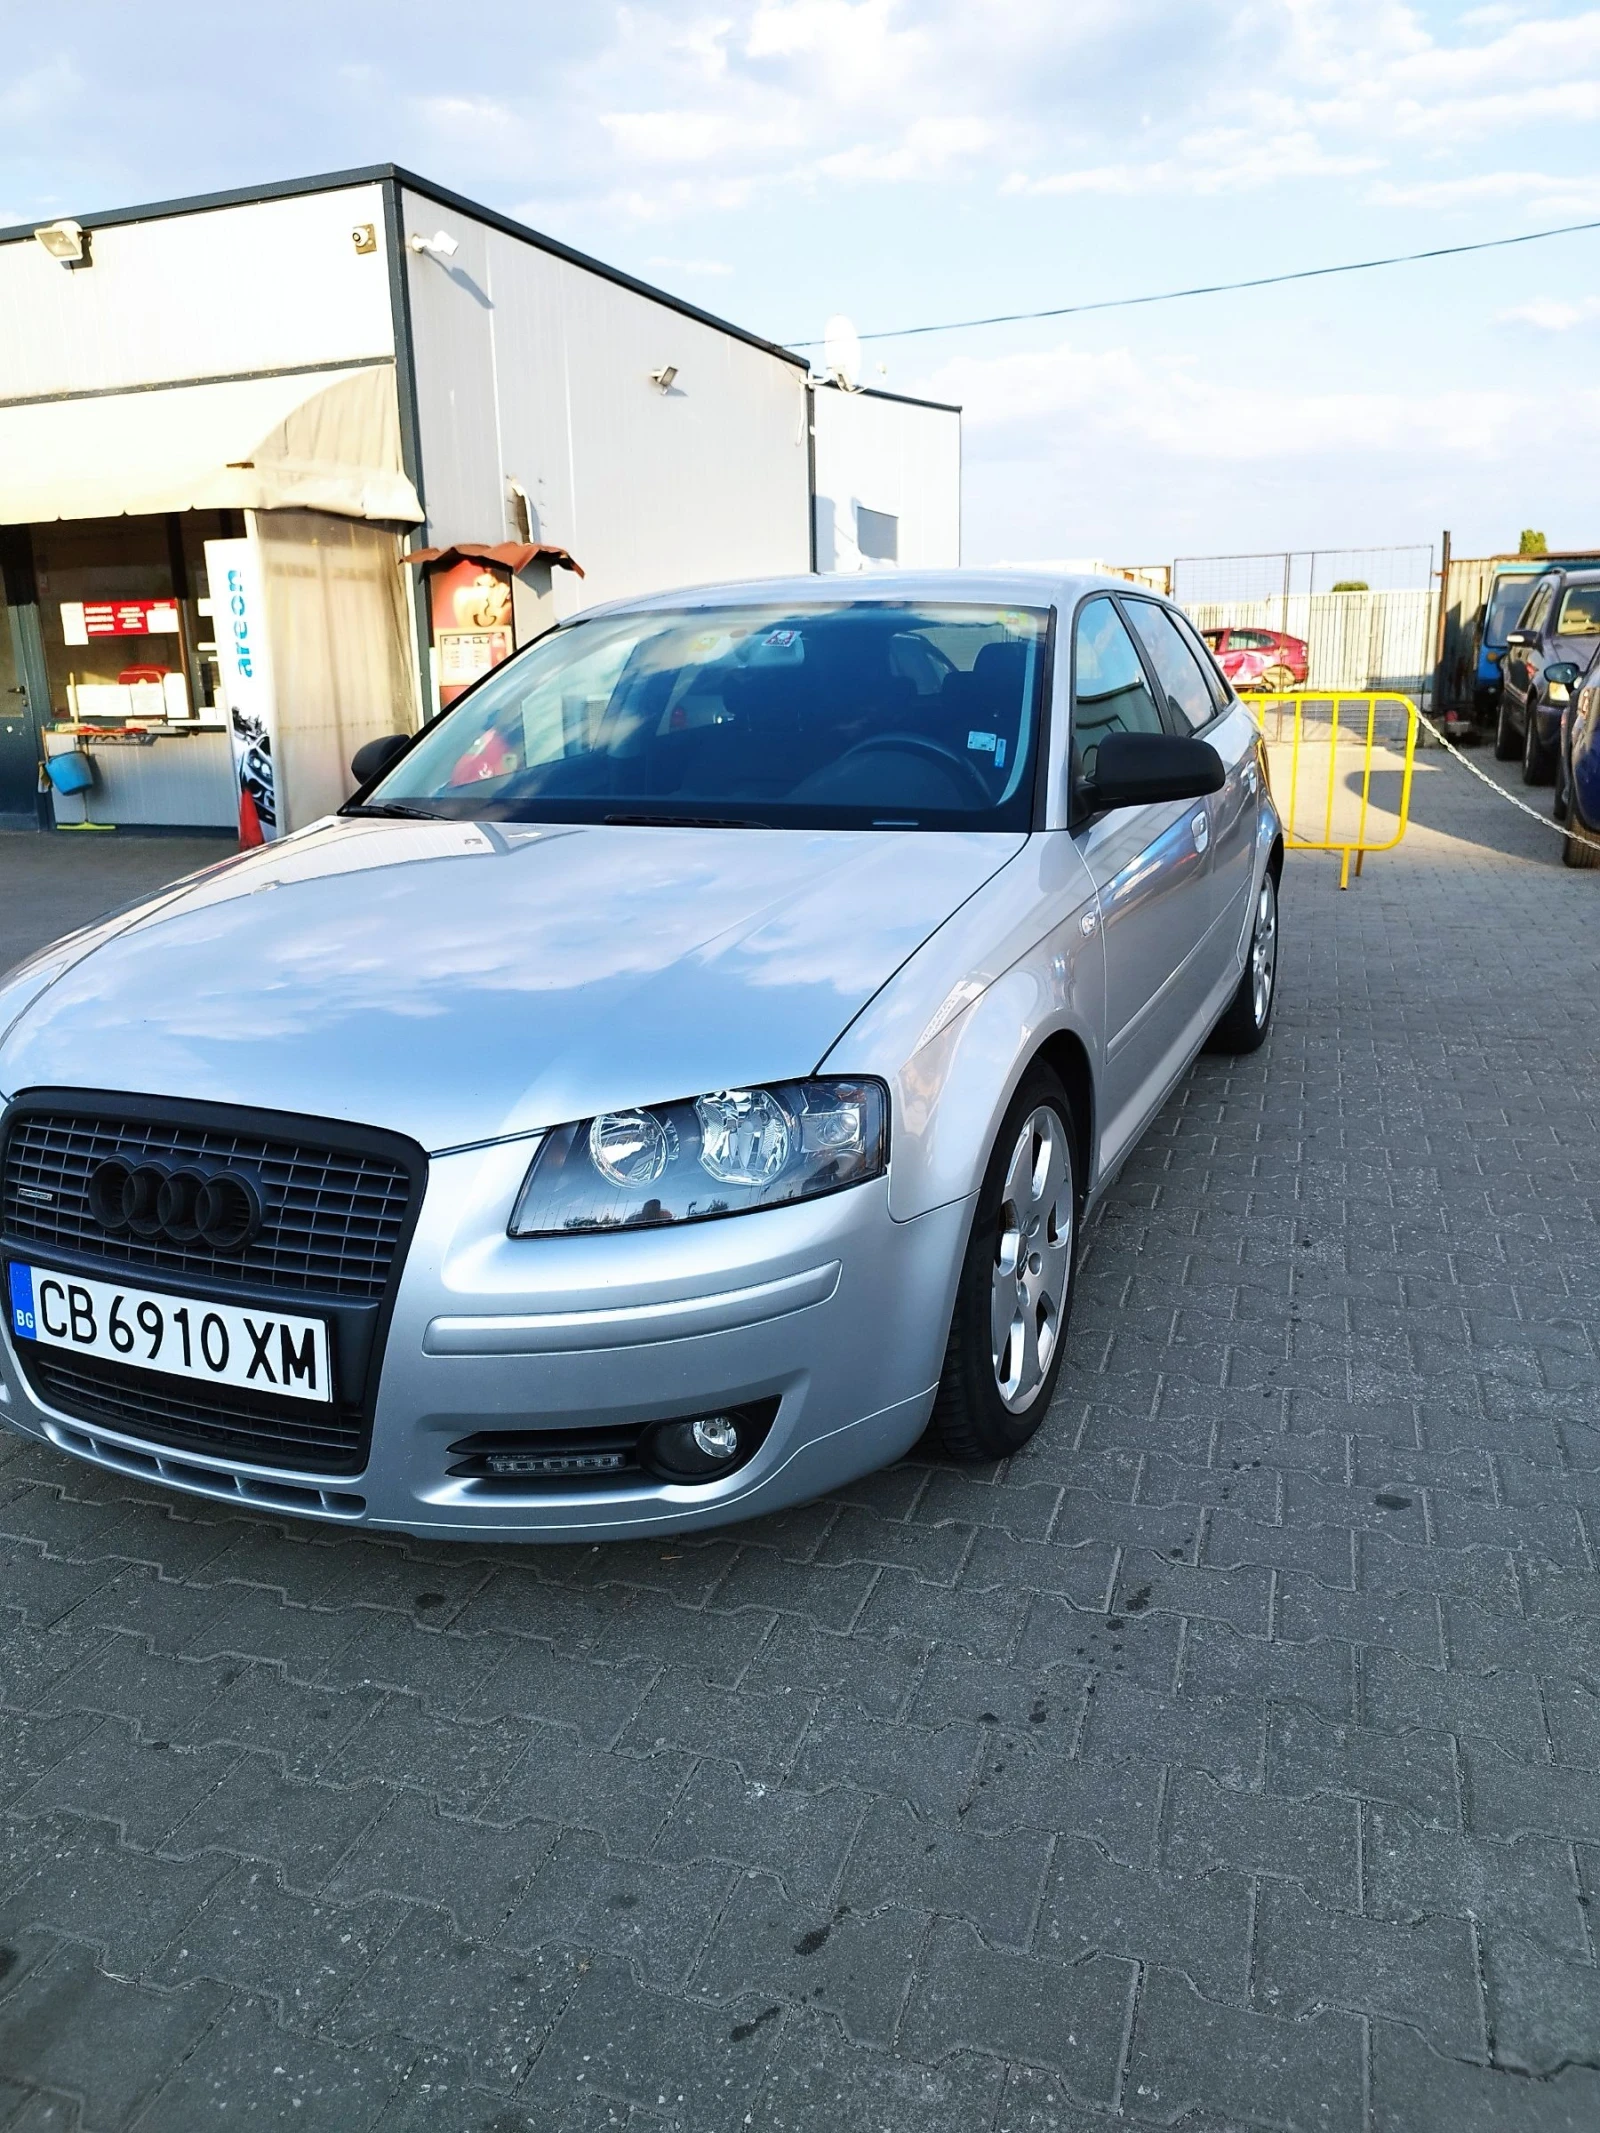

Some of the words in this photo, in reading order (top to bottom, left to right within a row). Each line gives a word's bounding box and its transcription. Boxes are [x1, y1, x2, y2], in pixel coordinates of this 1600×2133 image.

[228, 569, 252, 678] areon
[16, 1309, 35, 1329] BG
[39, 1279, 97, 1344] CB
[108, 1295, 230, 1373] 6910
[243, 1318, 317, 1390] XM
